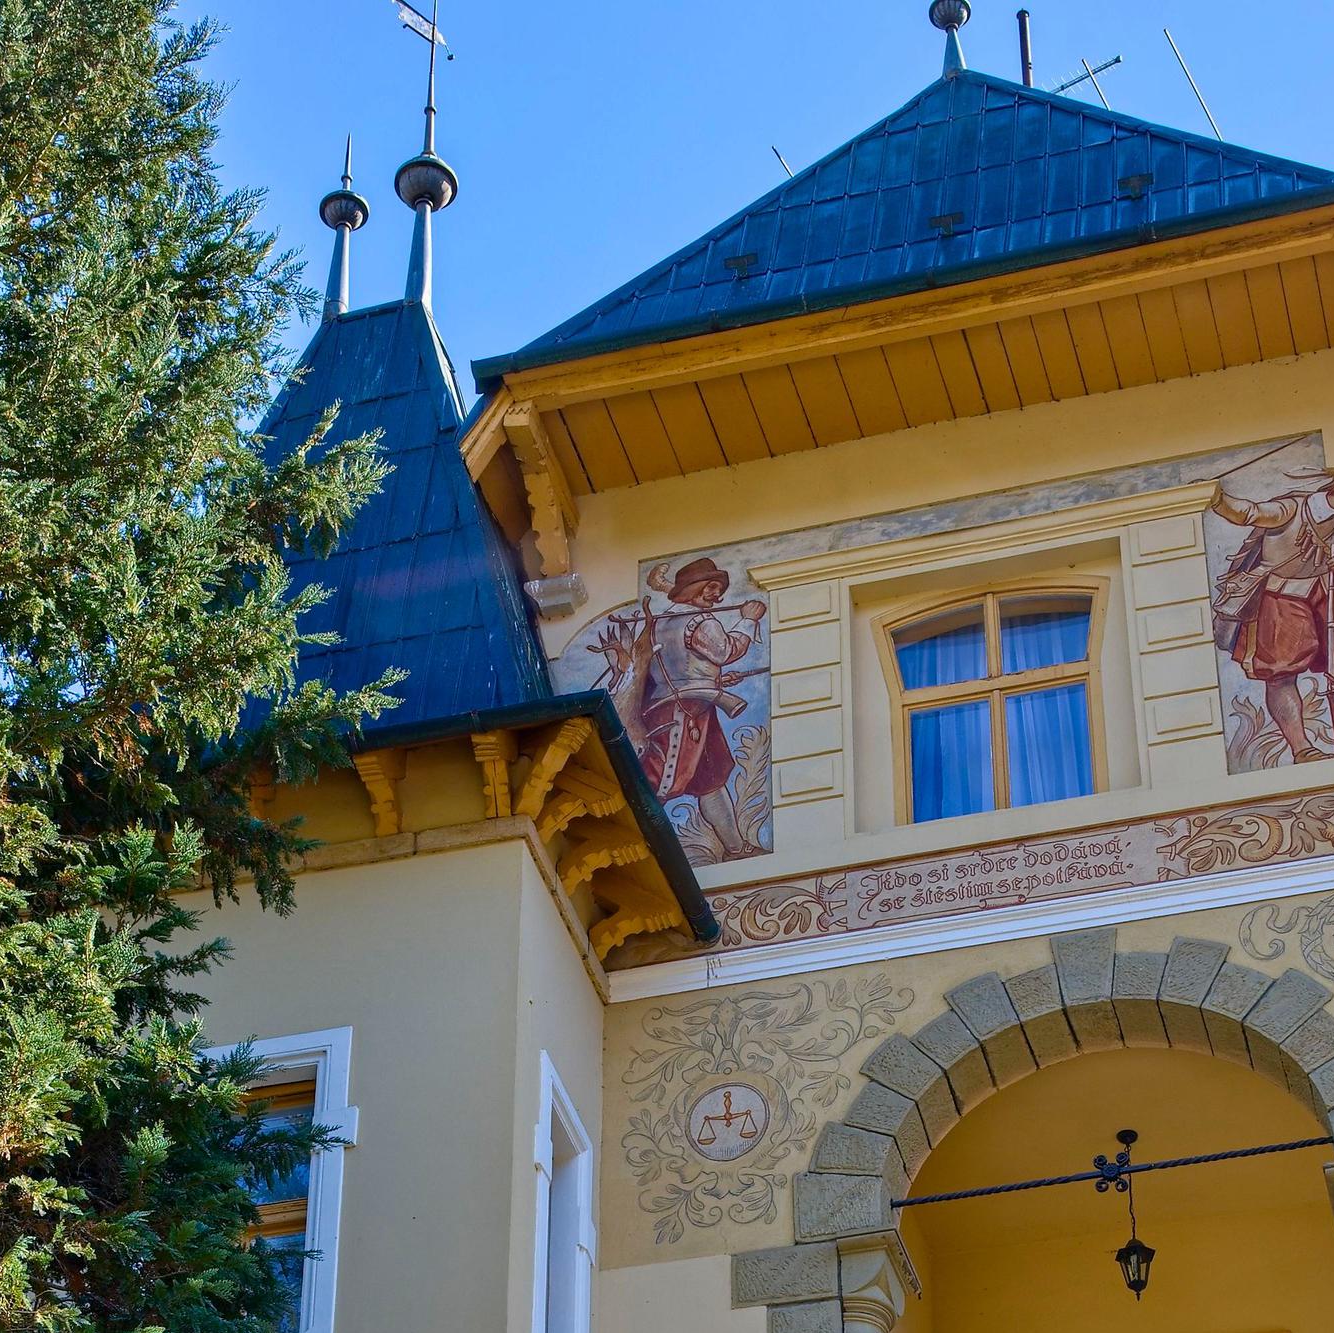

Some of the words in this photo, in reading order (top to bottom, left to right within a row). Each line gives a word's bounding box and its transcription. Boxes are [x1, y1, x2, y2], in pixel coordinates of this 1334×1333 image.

[857, 870, 923, 908] Kdo
[927, 863, 950, 883] si
[954, 854, 1019, 879] srdce
[878, 896, 907, 913] se
[996, 877, 1023, 894] se
